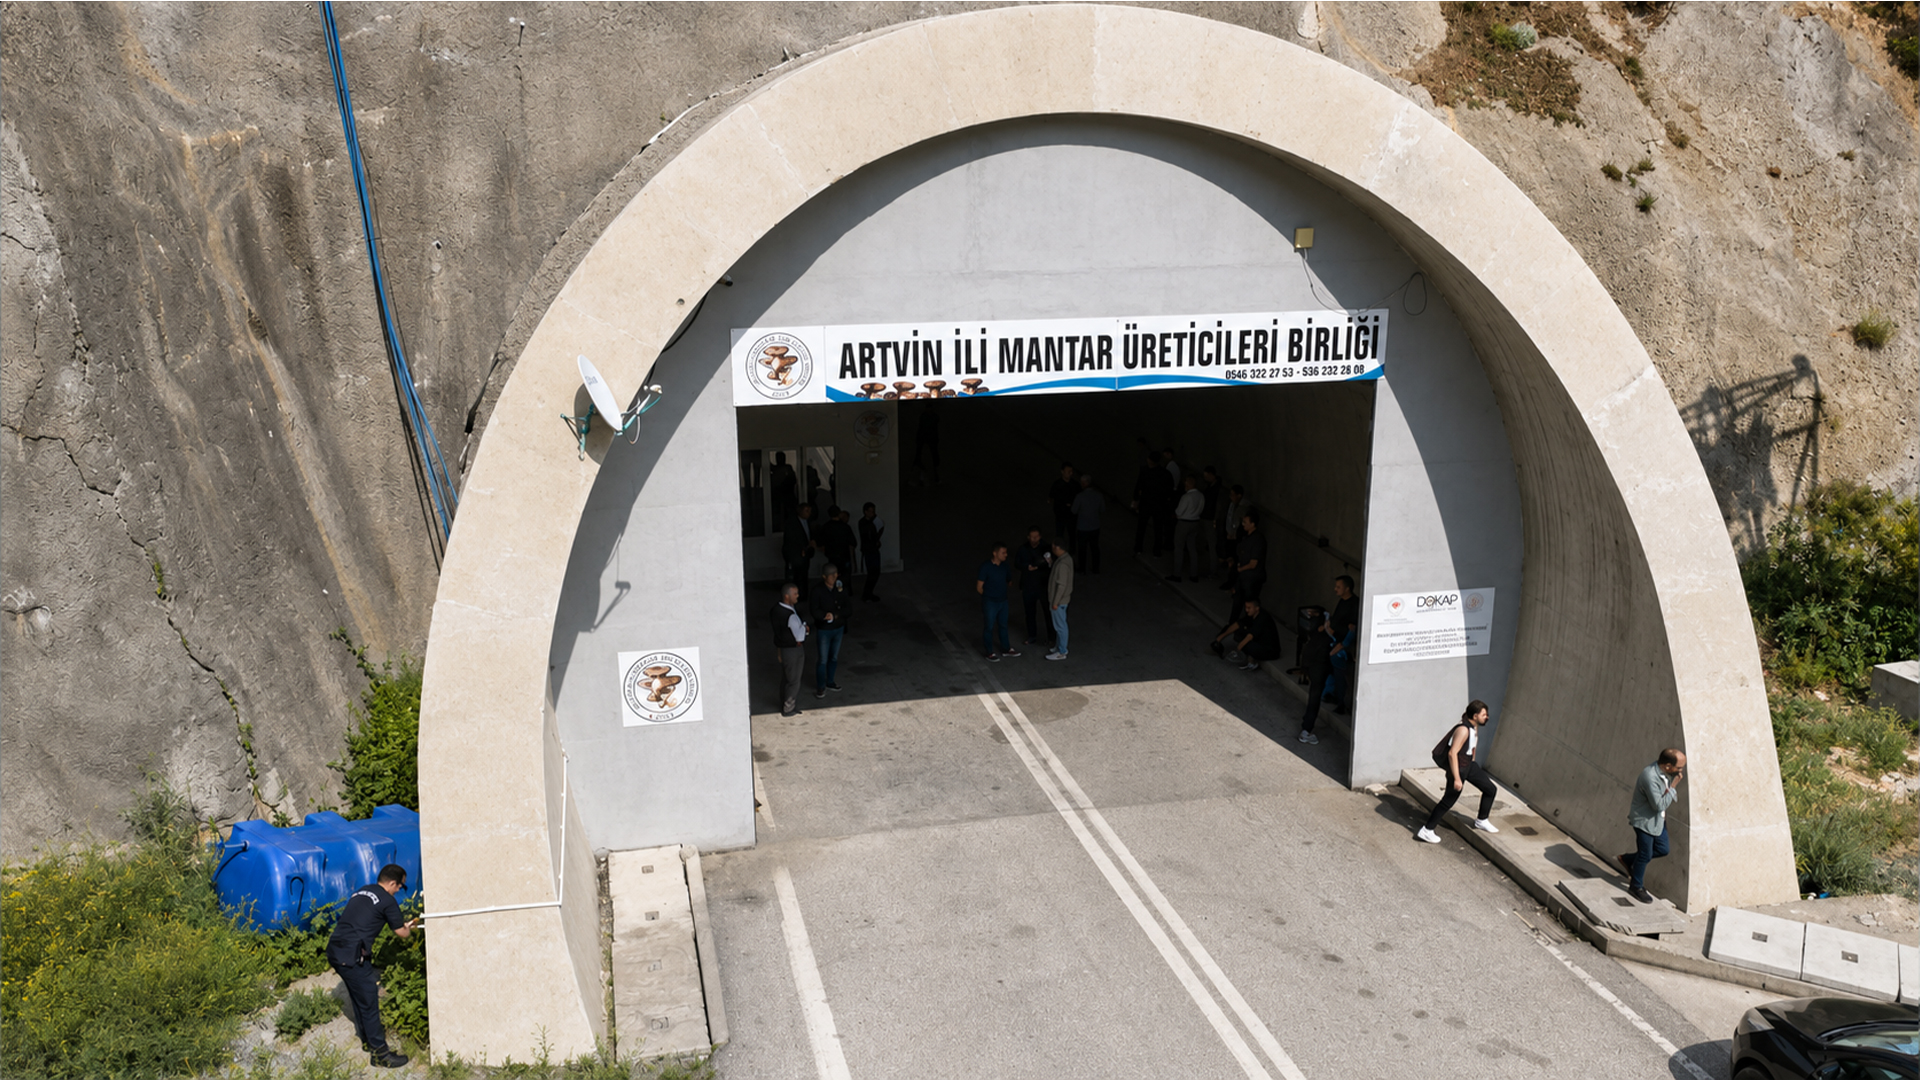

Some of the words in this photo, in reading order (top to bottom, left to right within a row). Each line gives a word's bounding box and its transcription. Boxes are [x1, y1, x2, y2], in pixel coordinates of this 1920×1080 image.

[839, 330, 942, 379] ARTVİN
[955, 328, 987, 375] İLİ
[999, 335, 1113, 373] MANTAR
[1123, 319, 1278, 369] ÜRETİCİLERİ
[1287, 315, 1379, 362] BİRLİĞİ
[1225, 369, 1248, 380] 0546
[1250, 368, 1267, 379] 322
[1269, 367, 1280, 378] 27
[1282, 367, 1294, 377] 53
[1302, 366, 1320, 376] 536
[1322, 365, 1338, 376] 232
[1416, 594, 1458, 607] DOKAP
